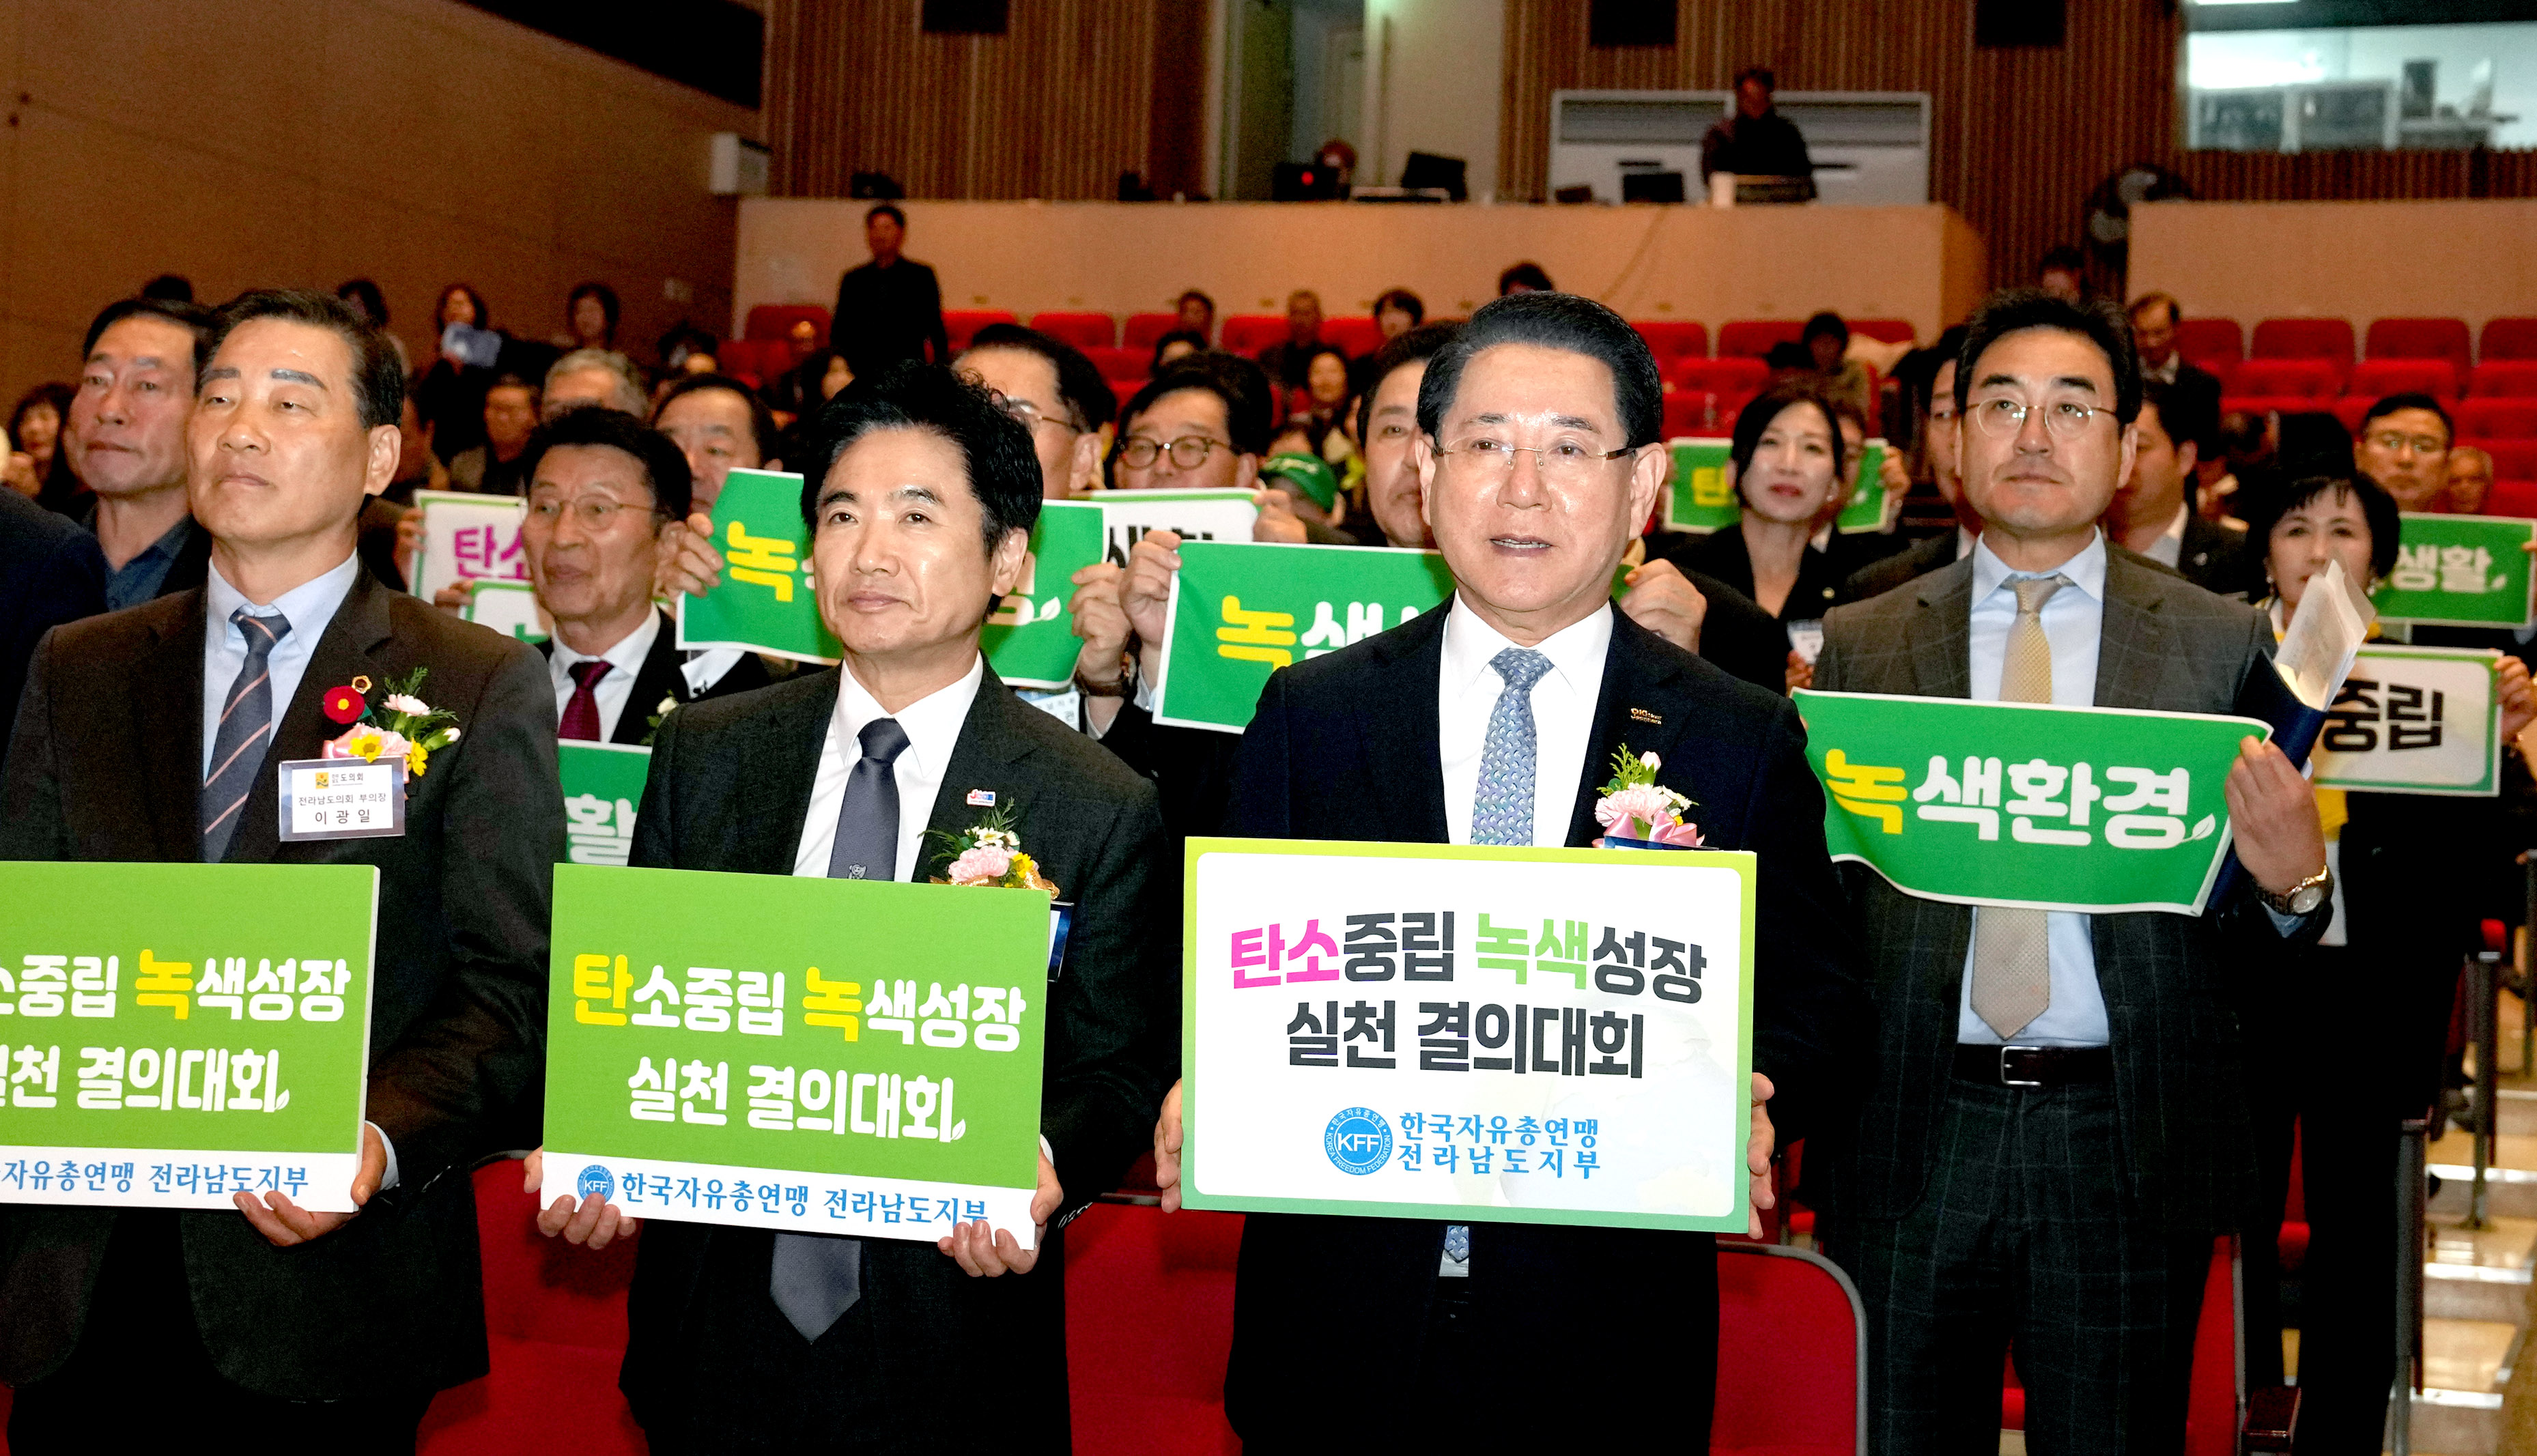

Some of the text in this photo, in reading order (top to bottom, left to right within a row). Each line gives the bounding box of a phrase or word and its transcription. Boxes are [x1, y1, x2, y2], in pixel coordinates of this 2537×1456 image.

[298, 793, 386, 806] 전라남도의회 부의장
[1826, 749, 2189, 849] 녹색환경
[135, 948, 352, 1022] 녹색성장
[1231, 911, 1707, 1004] 탄소중립 녹색성장
[573, 954, 1027, 1052] 탄소중립 녹색성장
[1287, 1000, 1644, 1079] 실천 결의대회
[0, 1044, 279, 1113] 천 결의대회
[628, 1056, 954, 1143] 실천 결의대회
[1326, 1132, 1391, 1174] KOREA FREEDOM FEDERATION
[1337, 1132, 1380, 1152] KFF
[1399, 1112, 1598, 1148] 한국자유총연맹
[0, 1160, 309, 1197] 자유총연맹 전라남도지부
[584, 1180, 608, 1193] KFF
[1398, 1143, 1600, 1179] 전라남도지부
[621, 1172, 988, 1229] 한국자유총연맹 전라남도지부
